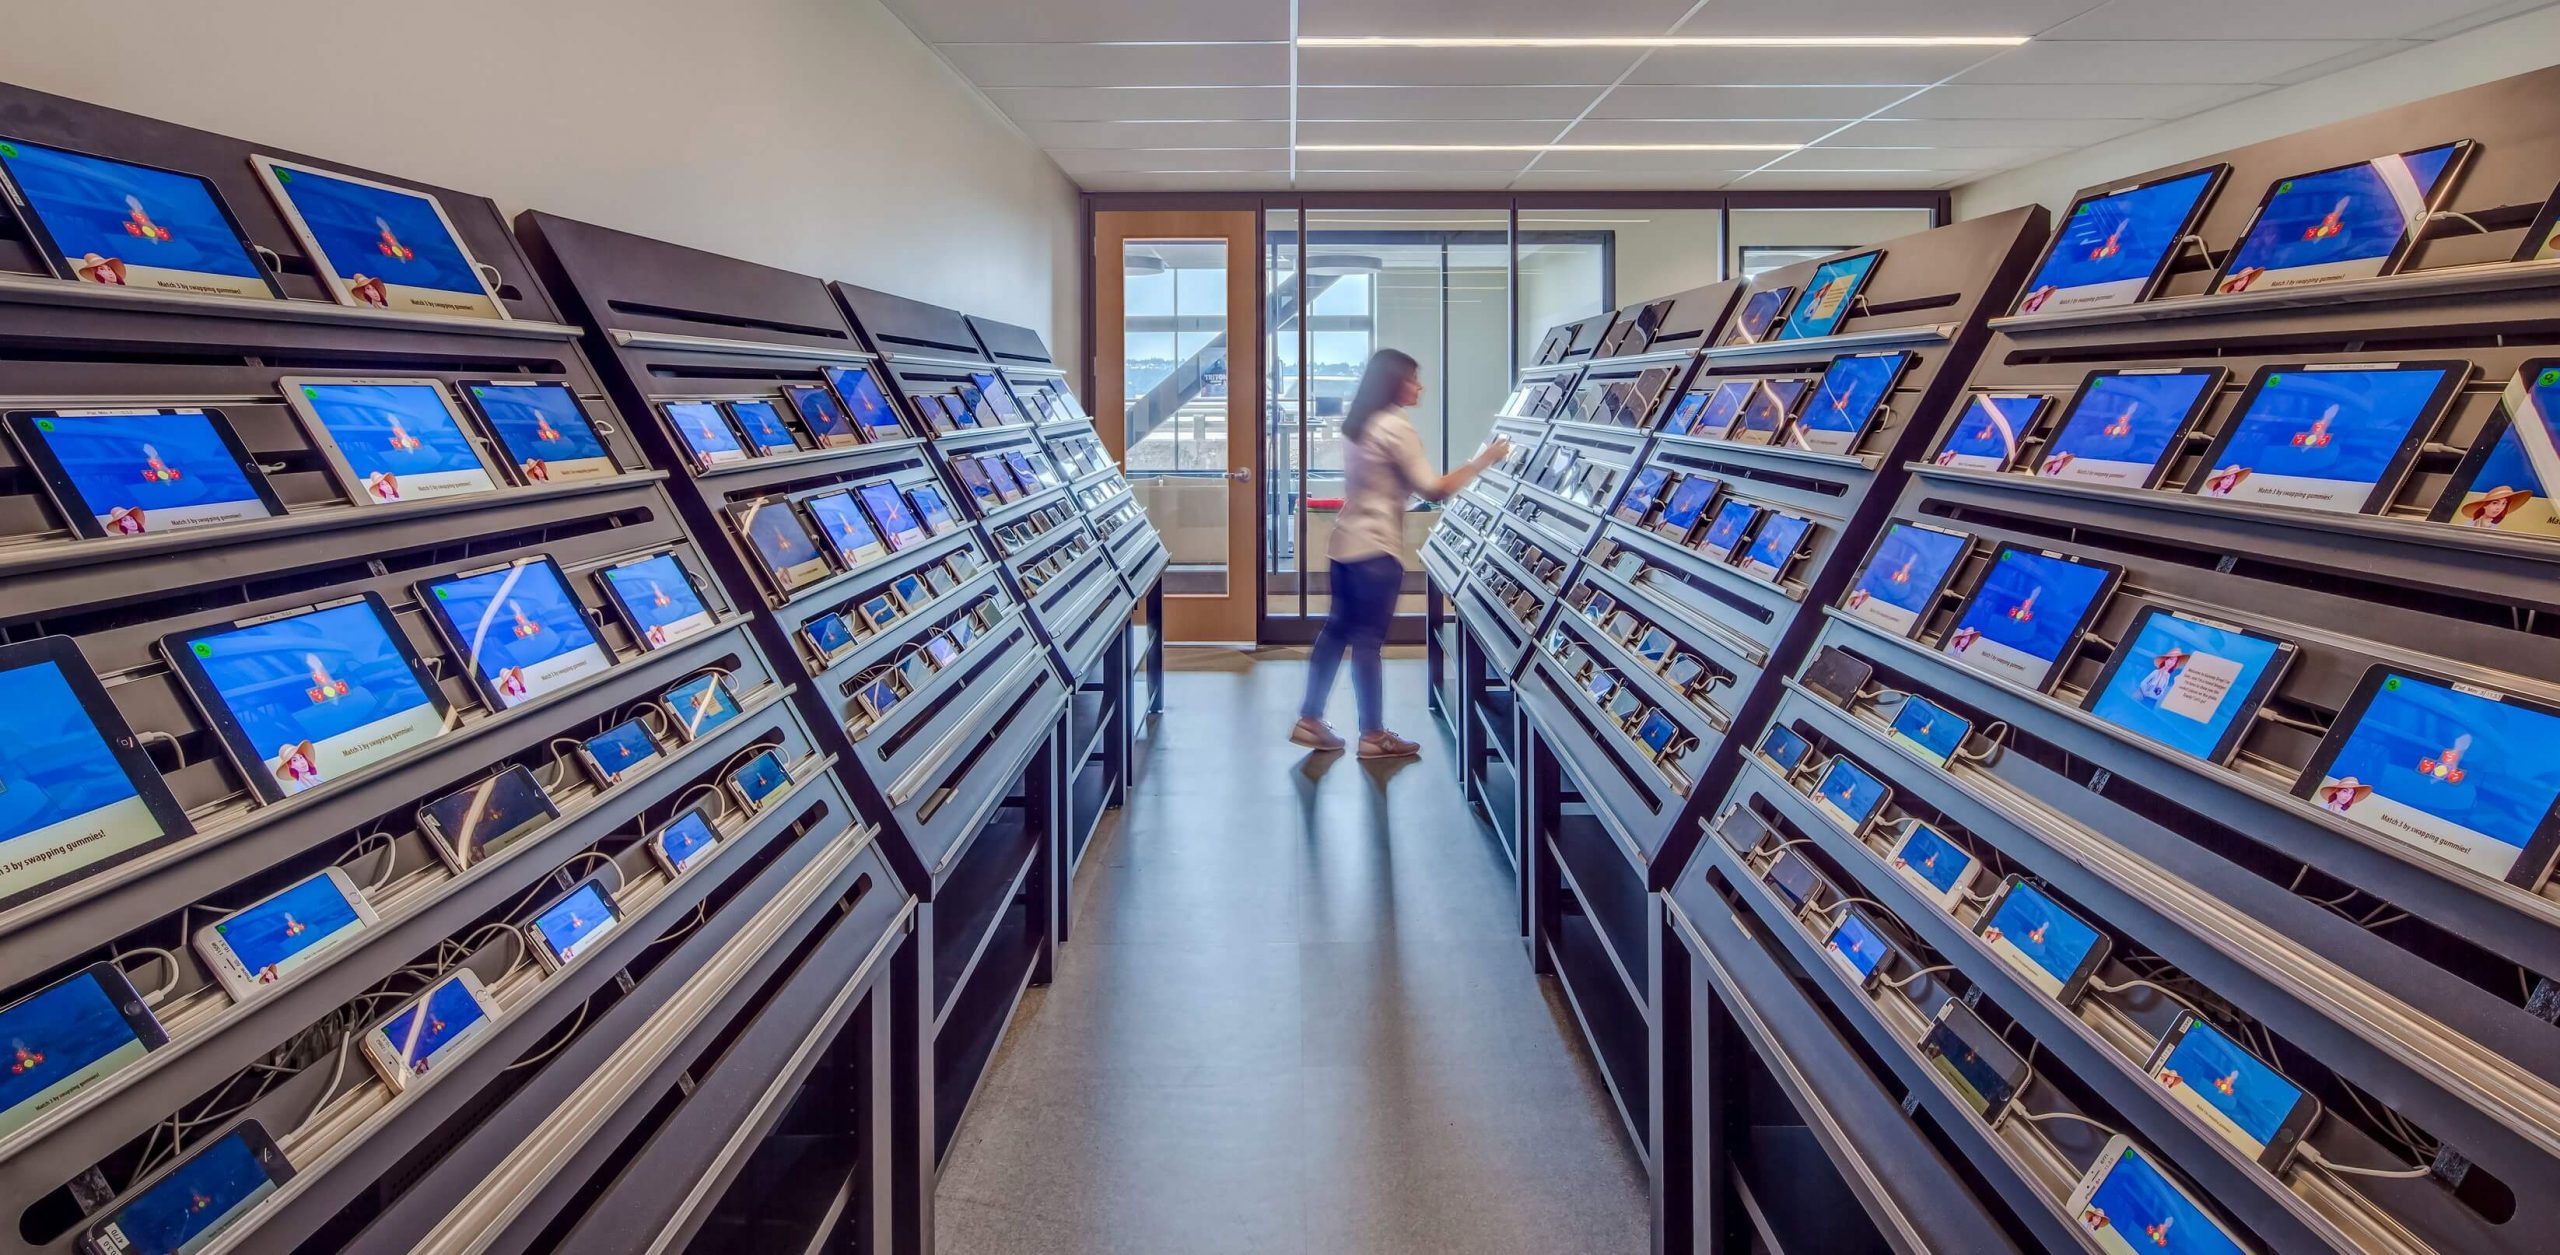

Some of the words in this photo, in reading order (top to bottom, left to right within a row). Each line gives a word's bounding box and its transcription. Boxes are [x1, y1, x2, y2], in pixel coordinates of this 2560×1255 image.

[4, 865, 10, 873] 3
[11, 860, 23, 871] by
[24, 846, 66, 866] swapping
[66, 830, 106, 852] gummies!
[2381, 814, 2399, 825] Match
[2403, 822, 2411, 832] by
[2411, 826, 2439, 843] swapping
[2439, 838, 2472, 854] gummies!
